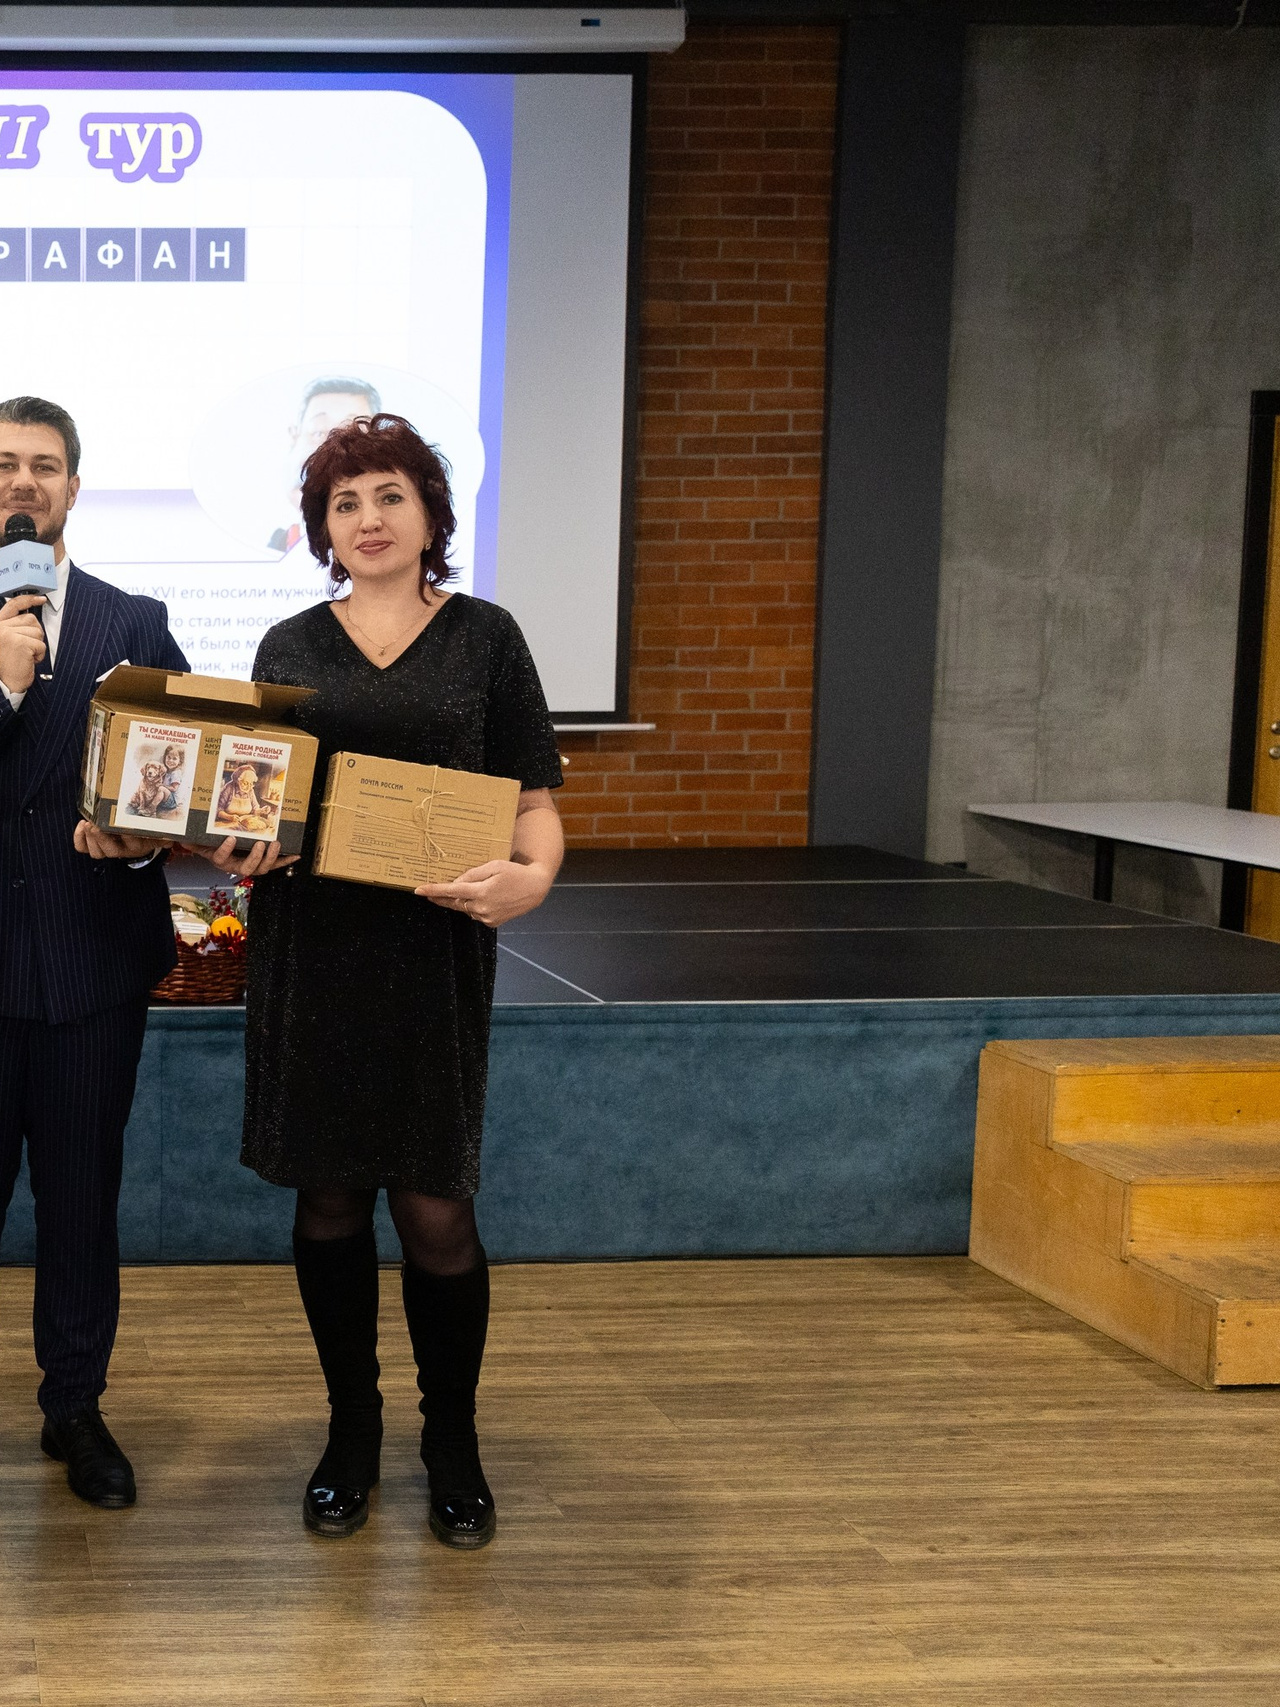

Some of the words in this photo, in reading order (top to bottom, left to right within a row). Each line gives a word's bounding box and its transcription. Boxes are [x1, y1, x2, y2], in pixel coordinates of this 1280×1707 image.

[85, 119, 196, 176] тур
[180, 588, 206, 599] его
[210, 588, 267, 599] носили
[188, 617, 232, 628] стали
[236, 616, 284, 627] носит
[199, 636, 241, 650] было
[138, 725, 149, 733] ТЫ
[149, 727, 197, 740] СРАЖАЕШЬСЯ
[232, 742, 253, 751] ЖДЕМ
[255, 746, 283, 756] РОДНЫХ
[360, 777, 379, 787] ПОЧТА
[380, 781, 404, 791] РОССИИ
